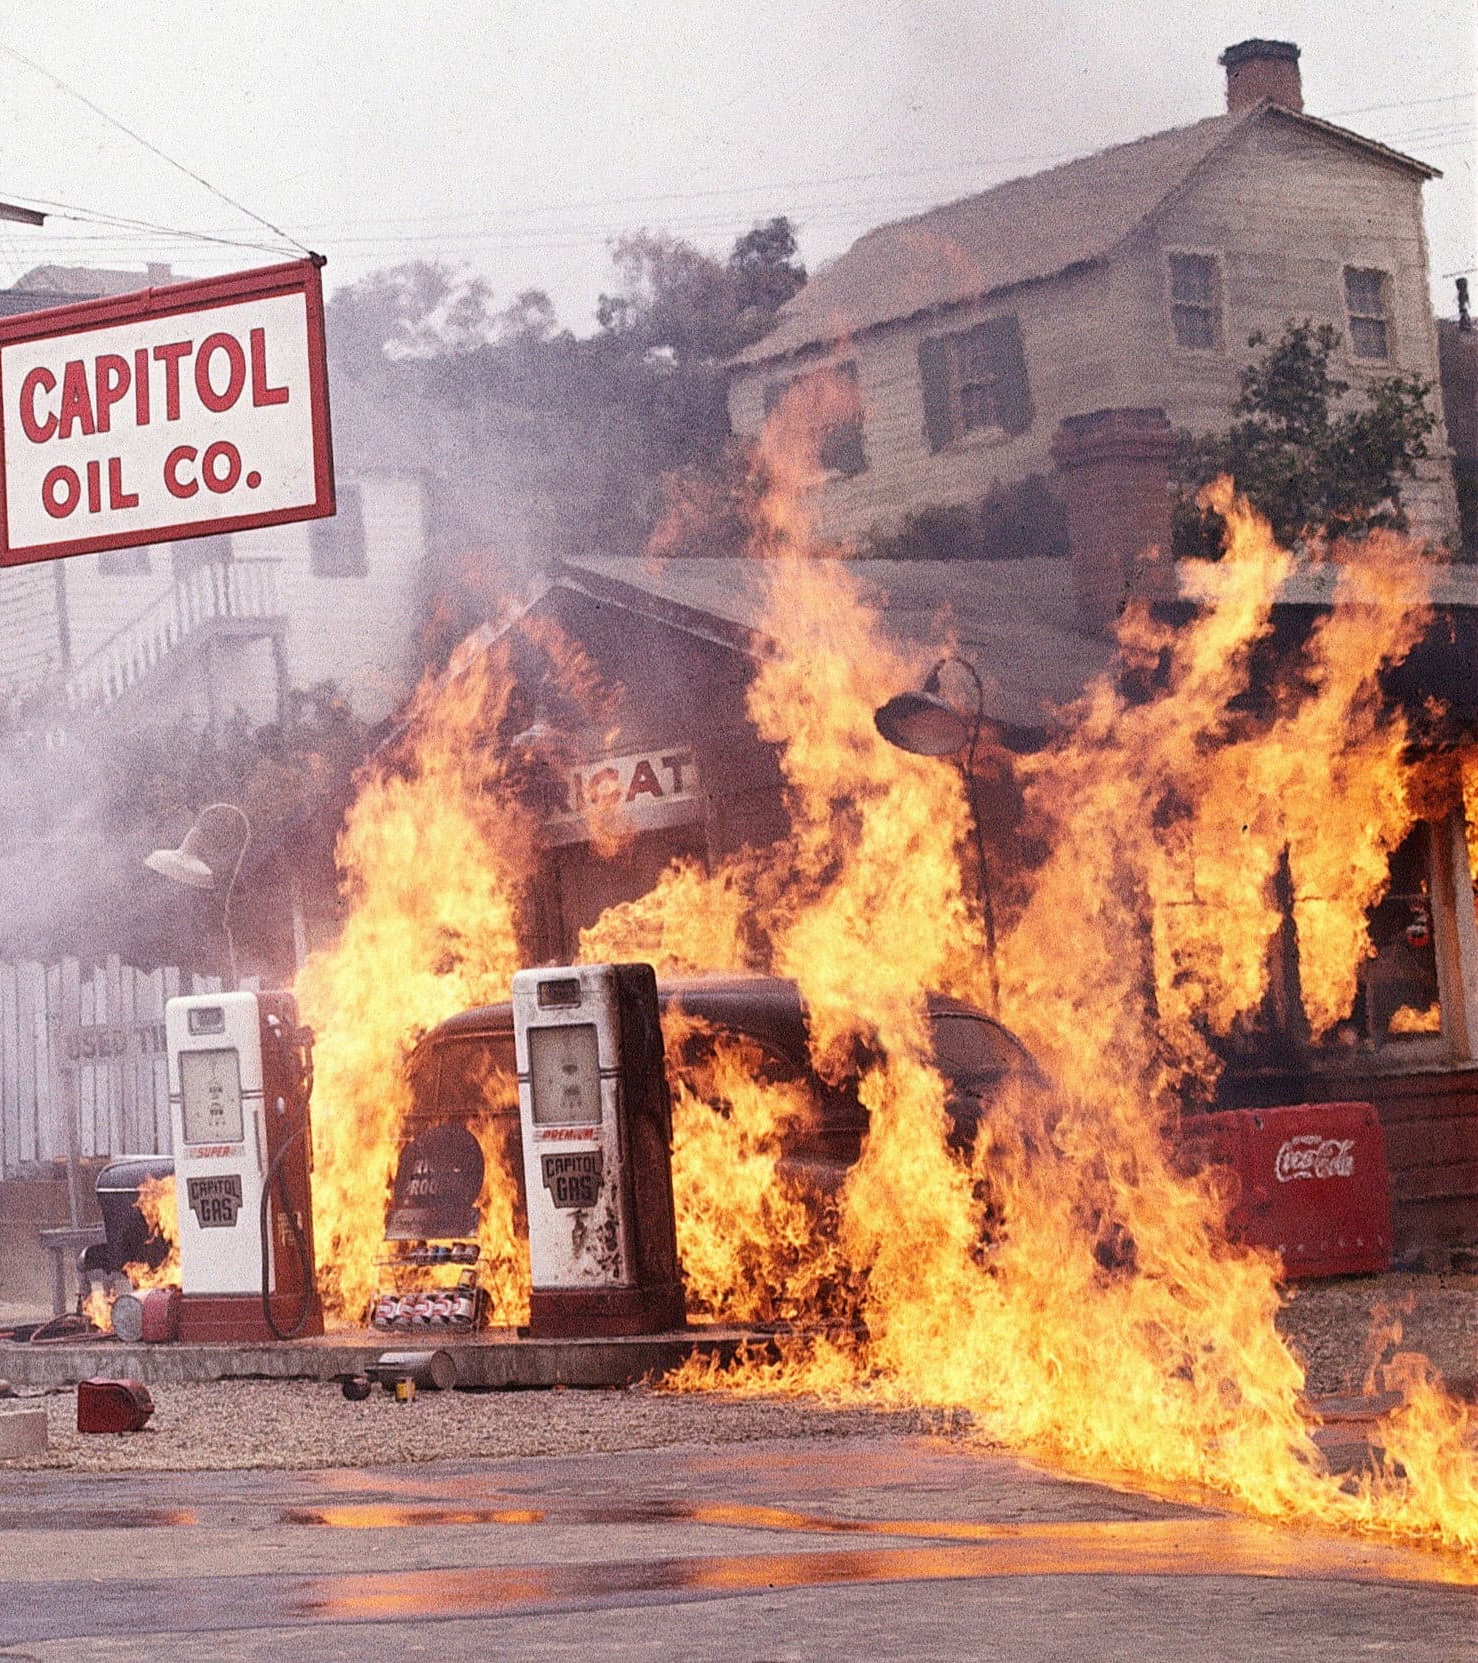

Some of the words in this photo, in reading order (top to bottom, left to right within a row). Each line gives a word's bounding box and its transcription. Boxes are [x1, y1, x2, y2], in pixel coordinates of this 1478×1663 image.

[19, 327, 289, 444] CAPITOL
[41, 457, 139, 519] OIL
[163, 440, 262, 499] CO.
[134, 1023, 167, 1056] TI
[541, 1127, 595, 1141] PREMIUM
[196, 1145, 231, 1158] SUPER
[1275, 1138, 1355, 1183] Coca-Cola
[544, 1155, 601, 1180] CAPITOL
[190, 1179, 240, 1201] CAPITOL
[556, 1175, 593, 1203] GAS
[201, 1196, 233, 1222] GAS
